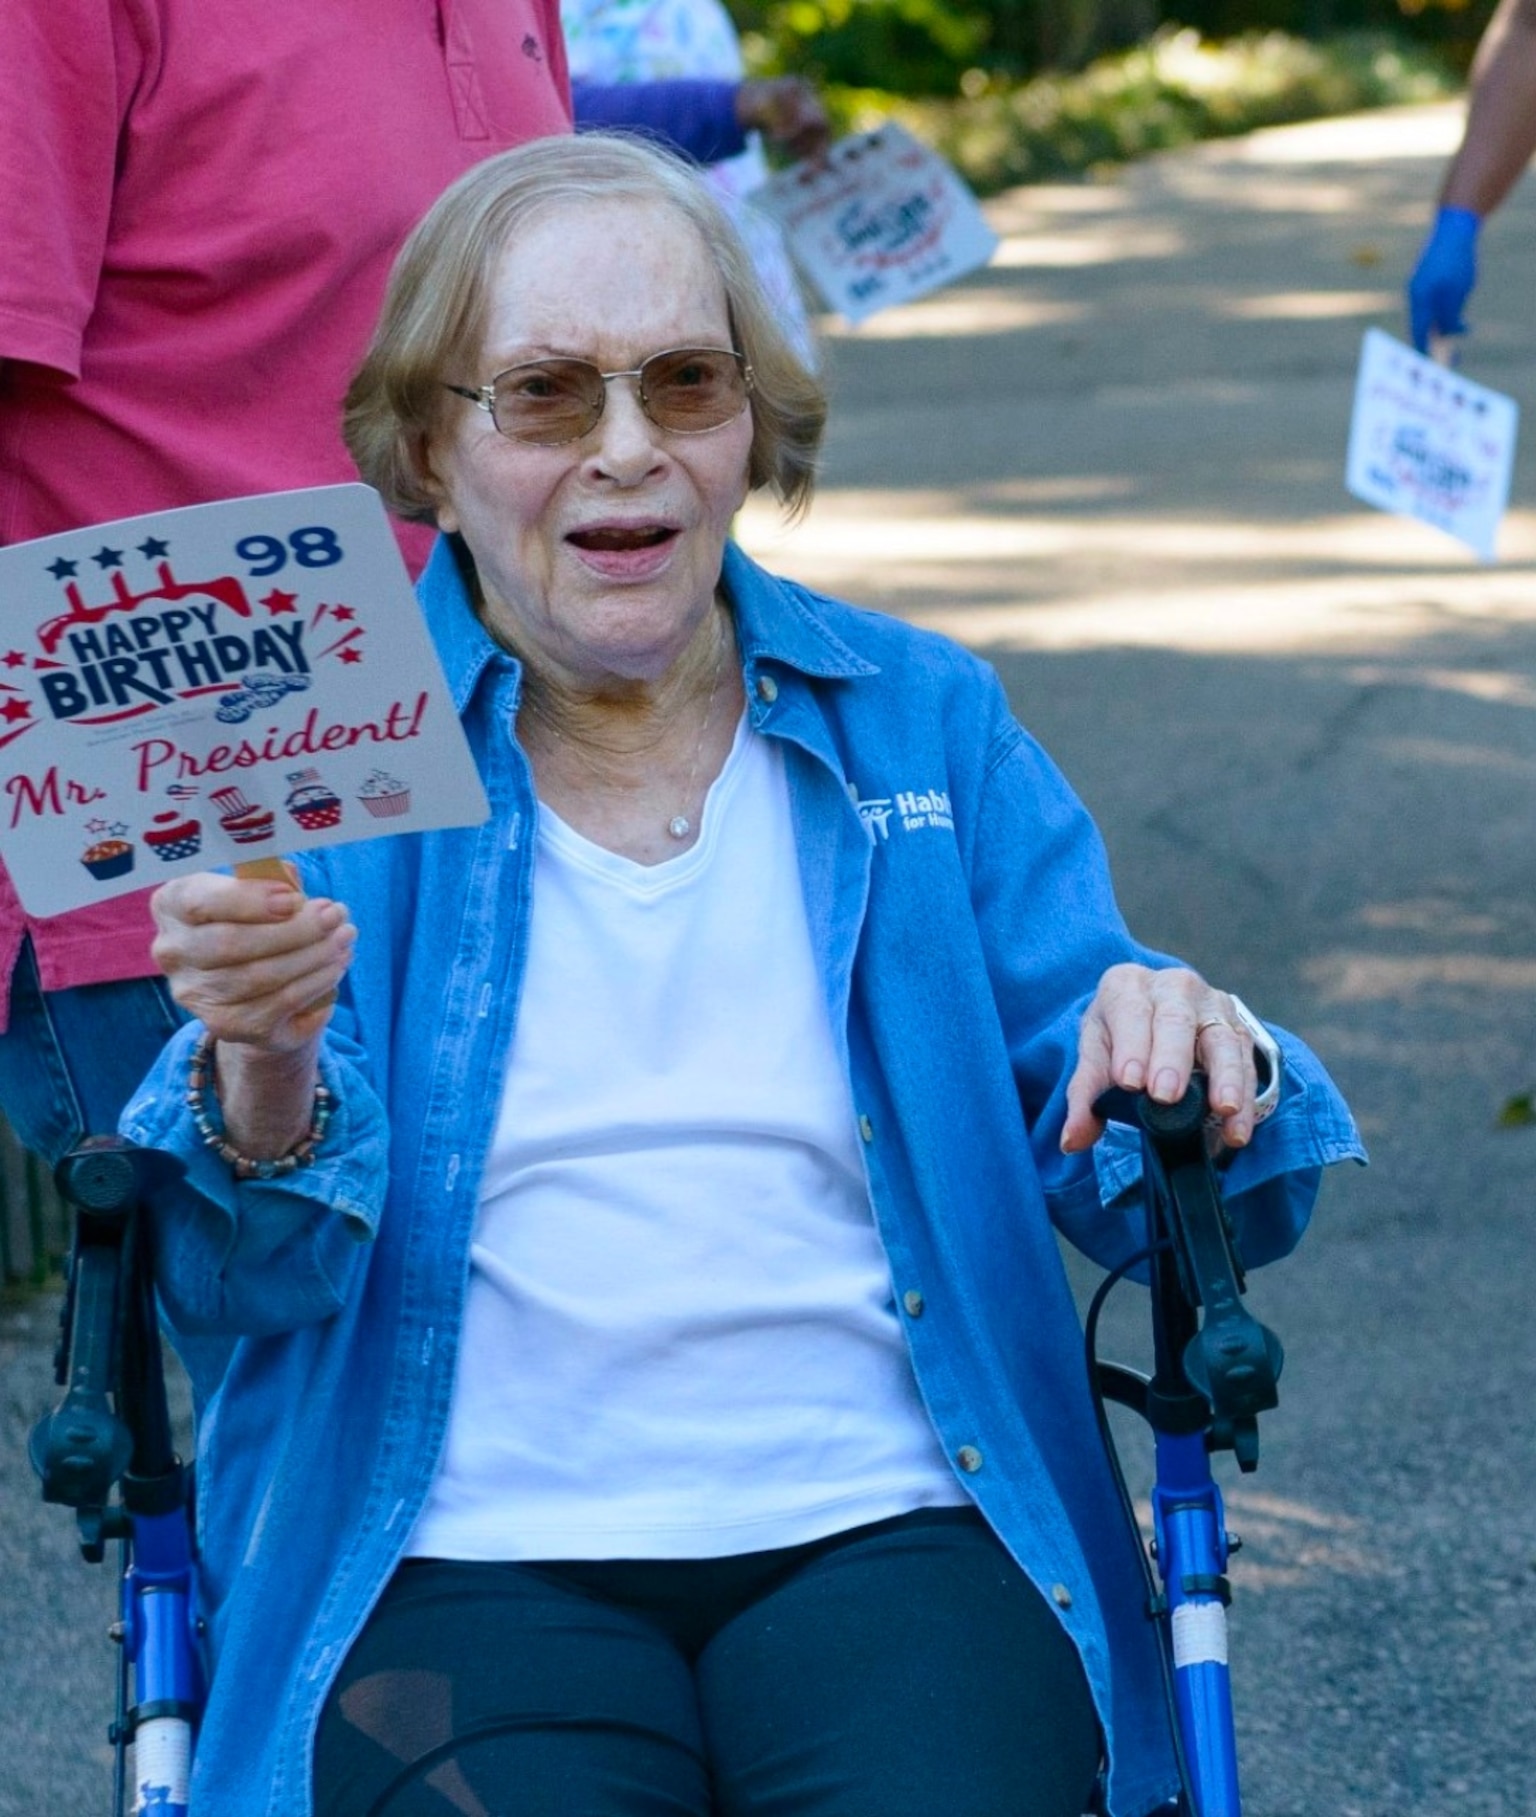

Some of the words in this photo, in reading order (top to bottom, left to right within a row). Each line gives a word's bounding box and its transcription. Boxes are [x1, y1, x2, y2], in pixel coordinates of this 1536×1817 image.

[235, 526, 344, 577] 98
[68, 602, 218, 663] HAPPY
[39, 619, 312, 720] BIRTHDAY
[5, 766, 107, 829] Mr.
[131, 690, 430, 792] President!
[903, 816, 926, 832] for
